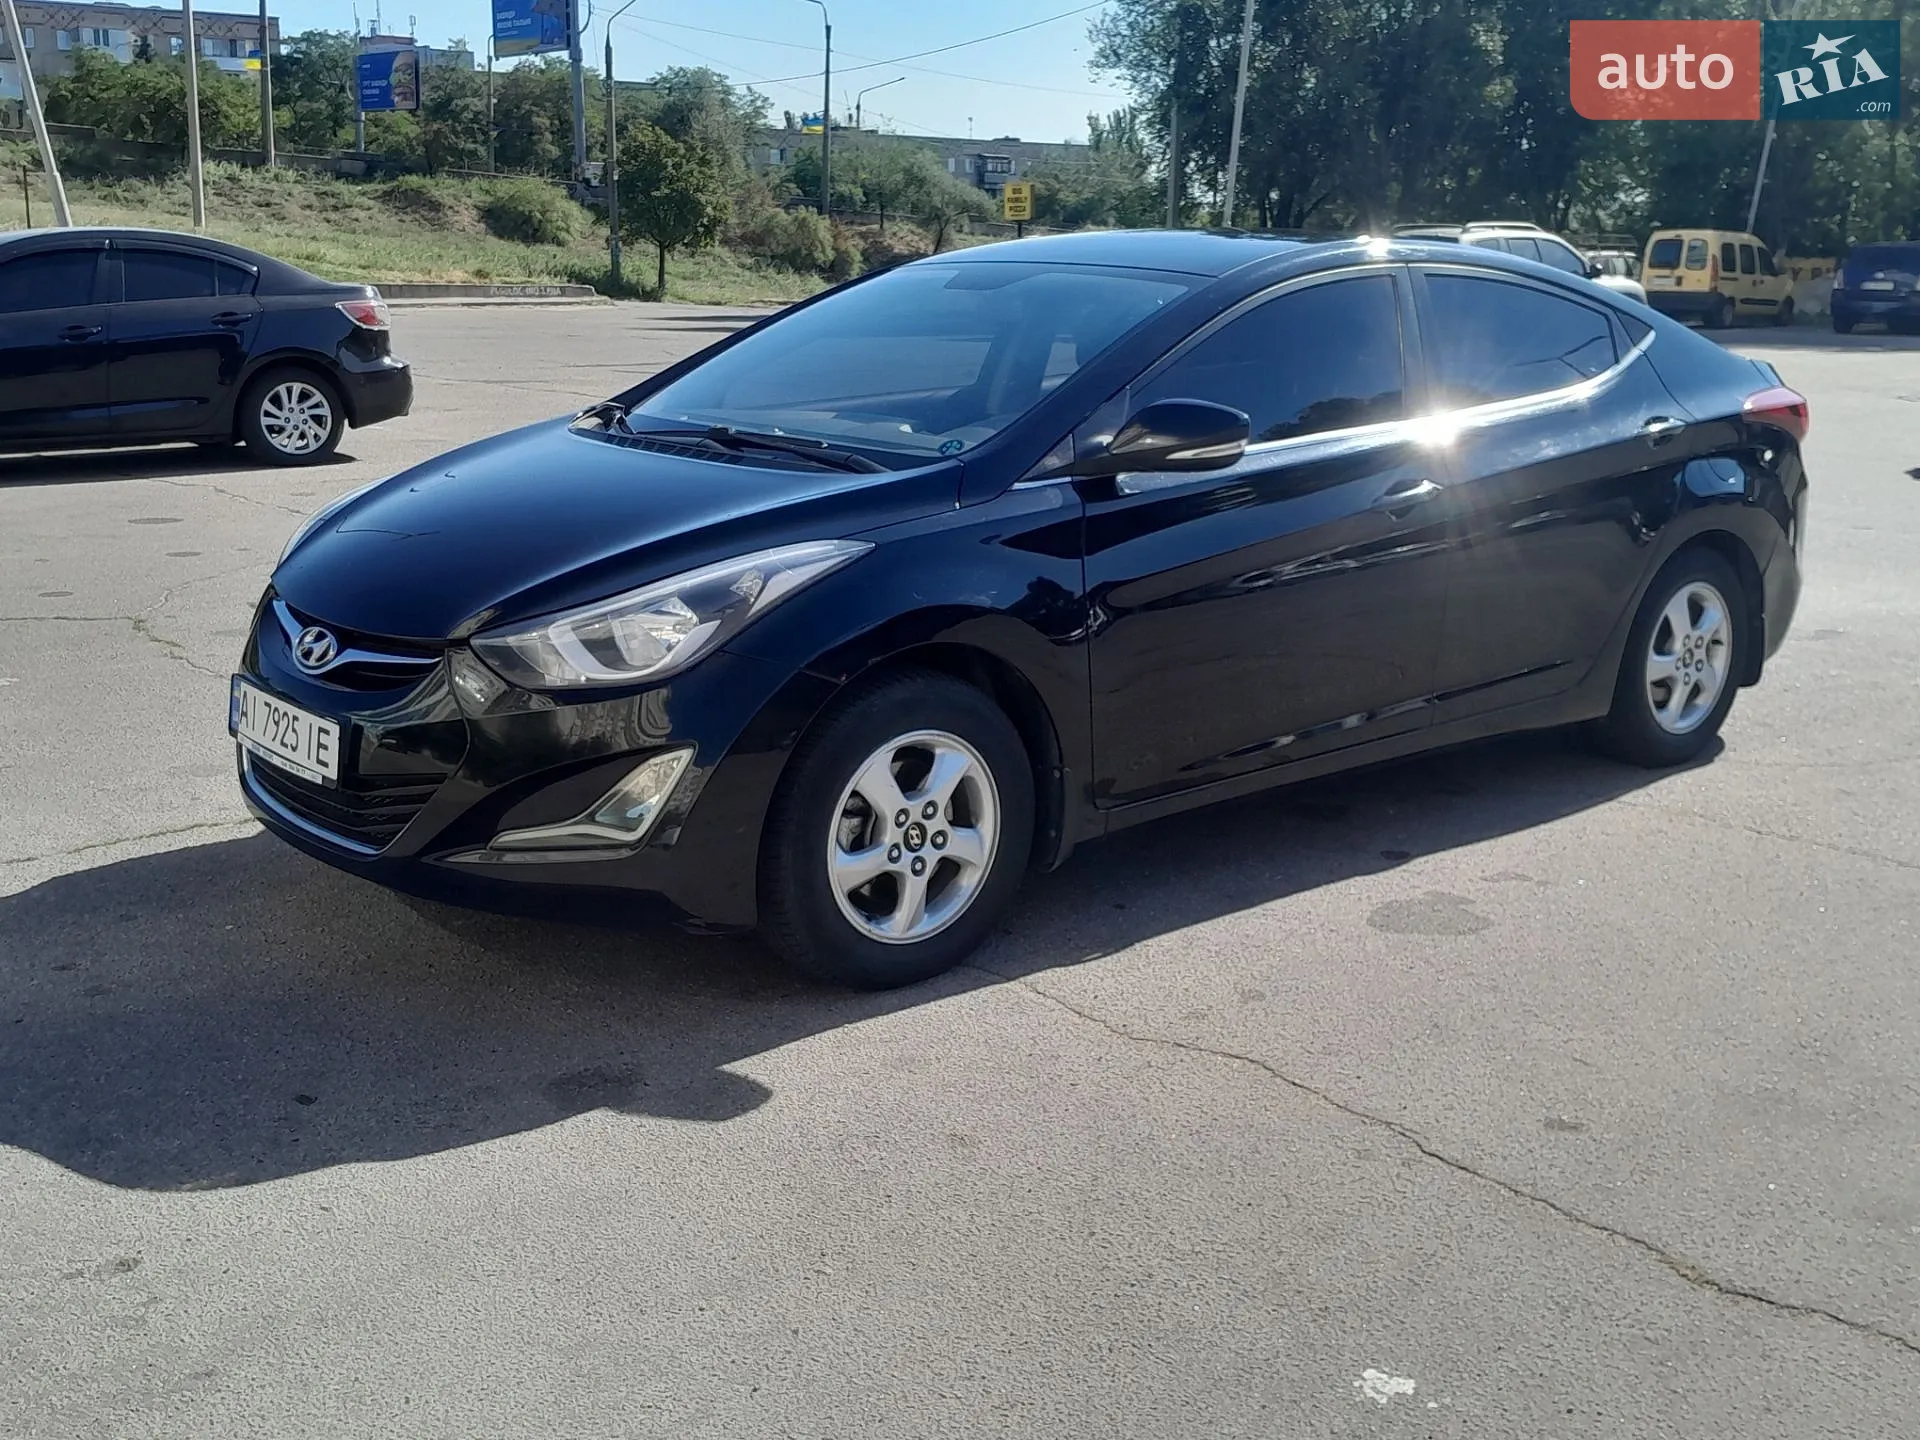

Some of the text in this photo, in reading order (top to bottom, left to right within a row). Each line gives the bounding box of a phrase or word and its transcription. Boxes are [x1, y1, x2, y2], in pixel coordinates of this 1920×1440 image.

[240, 690, 331, 769] AI 7925 IE
